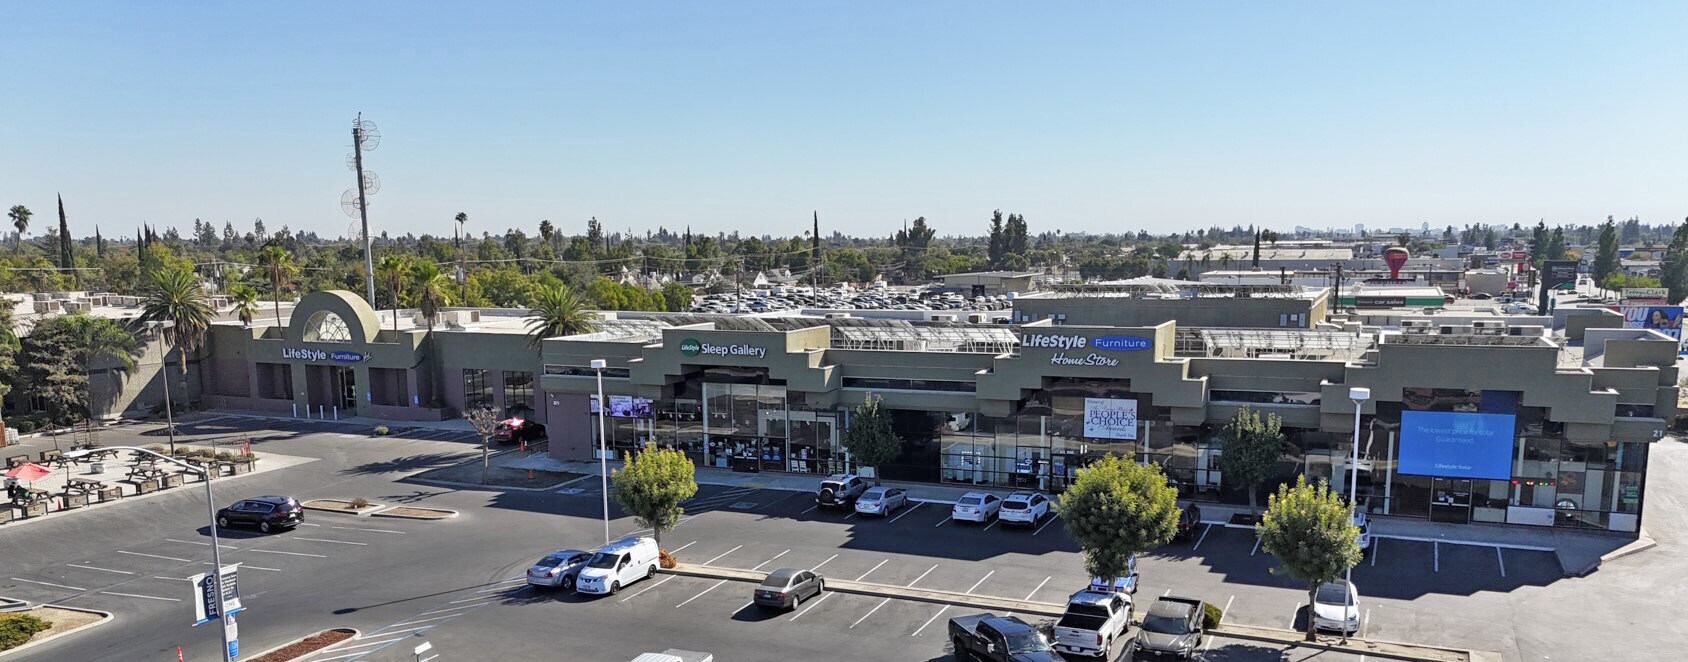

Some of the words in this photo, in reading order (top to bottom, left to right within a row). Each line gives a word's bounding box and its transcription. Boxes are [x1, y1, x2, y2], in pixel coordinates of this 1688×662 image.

[1022, 334, 1087, 350] LifeStyle
[1095, 338, 1147, 348] Furniture
[282, 348, 327, 362] LifeStyle
[330, 353, 361, 361] Furniture
[681, 344, 700, 352] LifeStyle
[701, 343, 729, 357] Sleep
[729, 344, 767, 359] Gallery
[1089, 410, 1136, 420] PEOPLE'S
[1090, 417, 1135, 427] CHOICE
[206, 576, 217, 616] FRESNO
